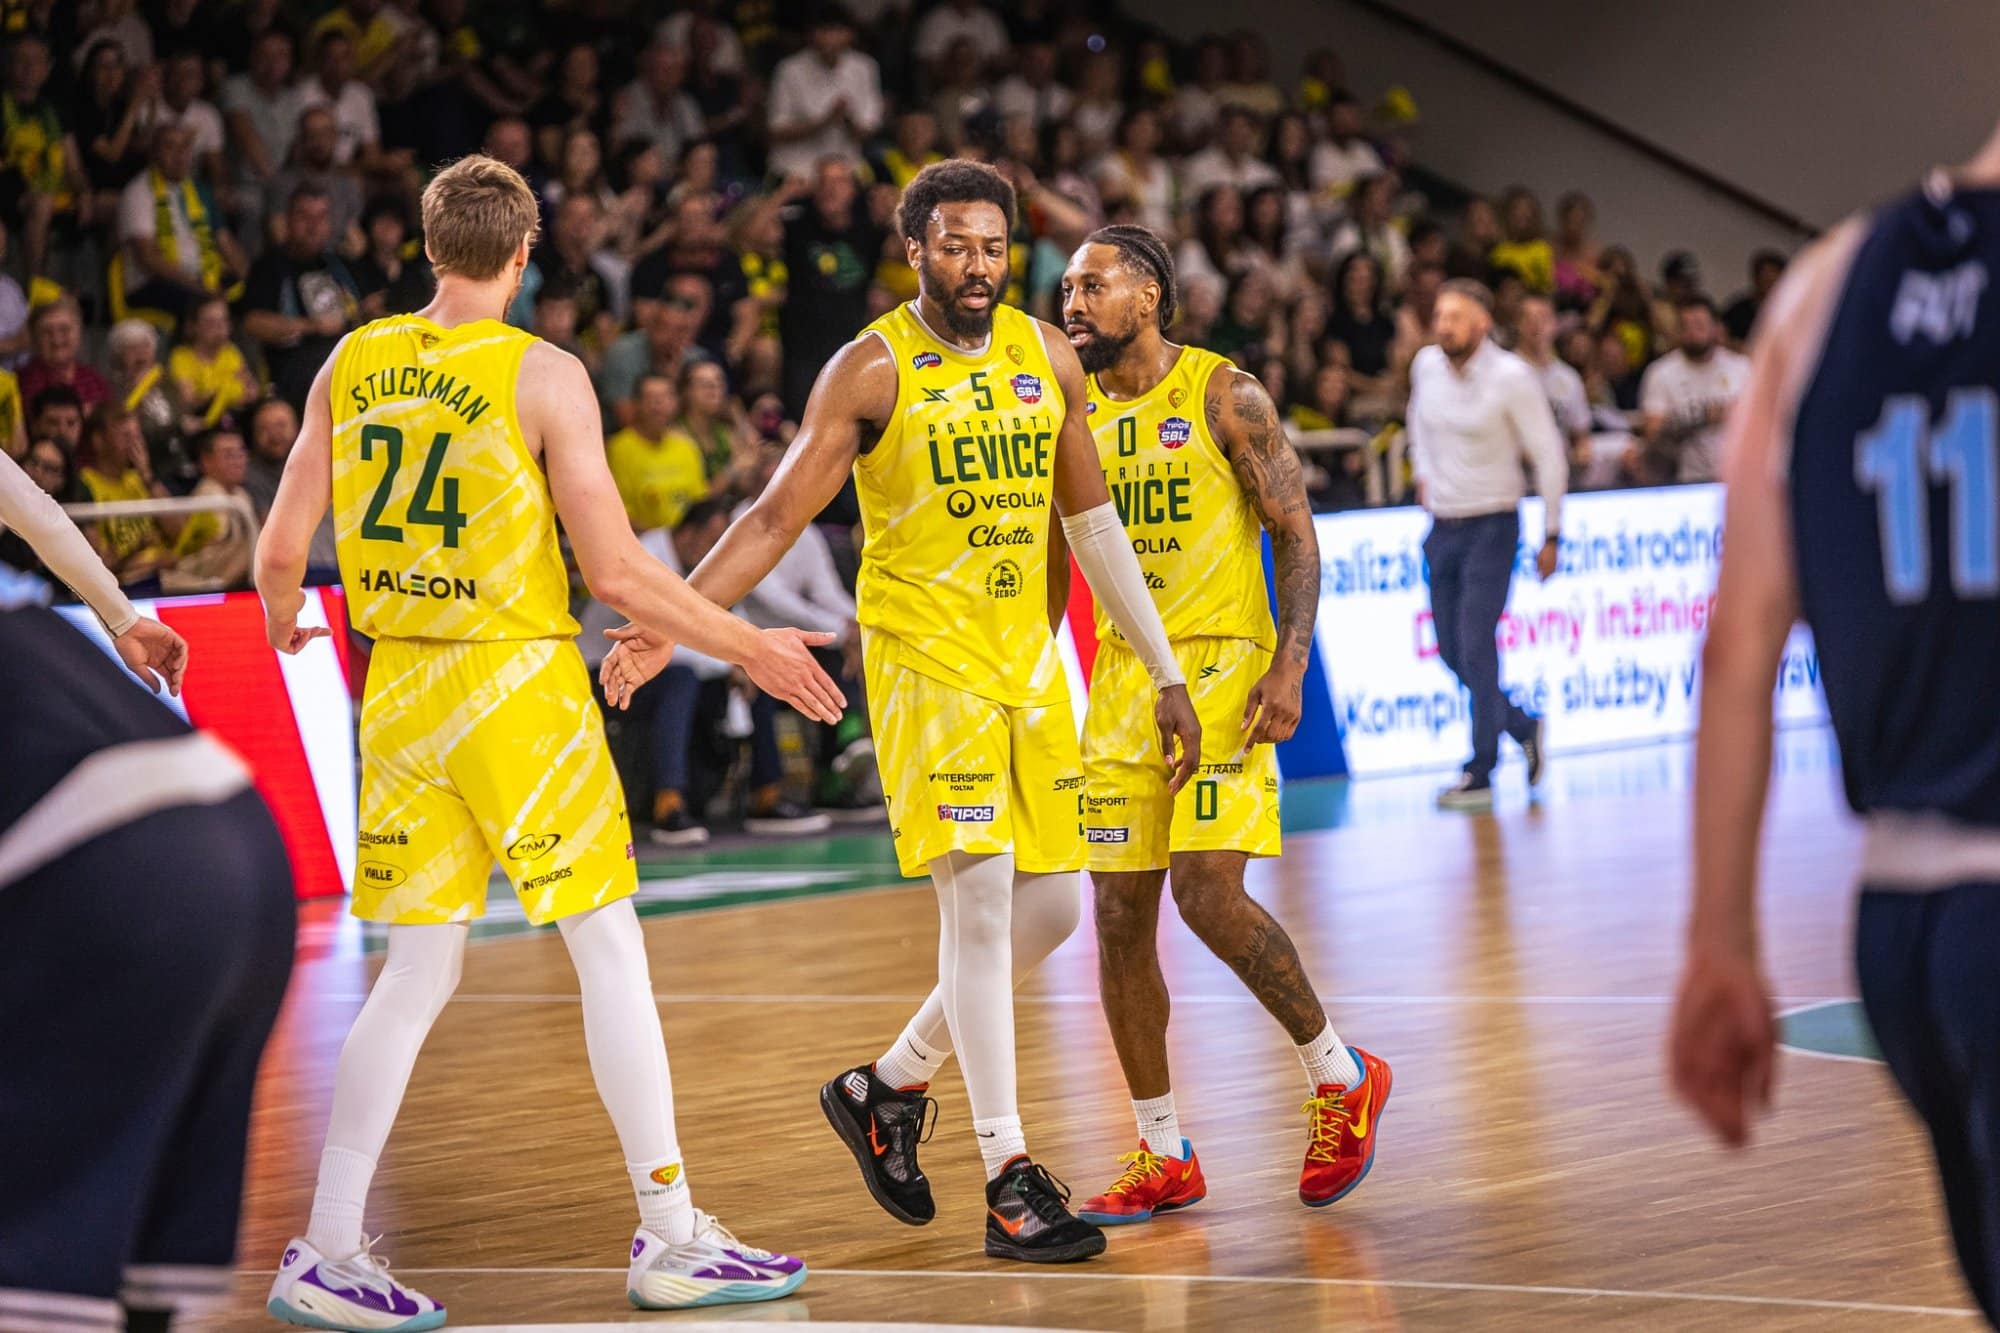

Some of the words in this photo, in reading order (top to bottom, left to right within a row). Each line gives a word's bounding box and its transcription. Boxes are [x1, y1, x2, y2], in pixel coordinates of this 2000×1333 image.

[351, 366, 490, 425] STUCKMAN
[970, 371, 994, 412] 5
[1016, 386, 1041, 397] SBL
[928, 415, 1051, 438] PATRIOTI
[1161, 430, 1187, 441] SBL
[928, 432, 1053, 486] LEVICE
[1102, 462, 1188, 482] TRIOTI
[360, 423, 467, 549] 24
[1854, 390, 2000, 602] 11
[980, 492, 1045, 510] VEOLIA
[1111, 478, 1193, 528] VICE
[967, 524, 1034, 548] Cloetta
[1132, 536, 1182, 554] OLIA
[360, 568, 477, 600] HALEON
[951, 807, 993, 821] TIPOS
[519, 839, 546, 853] TAM
